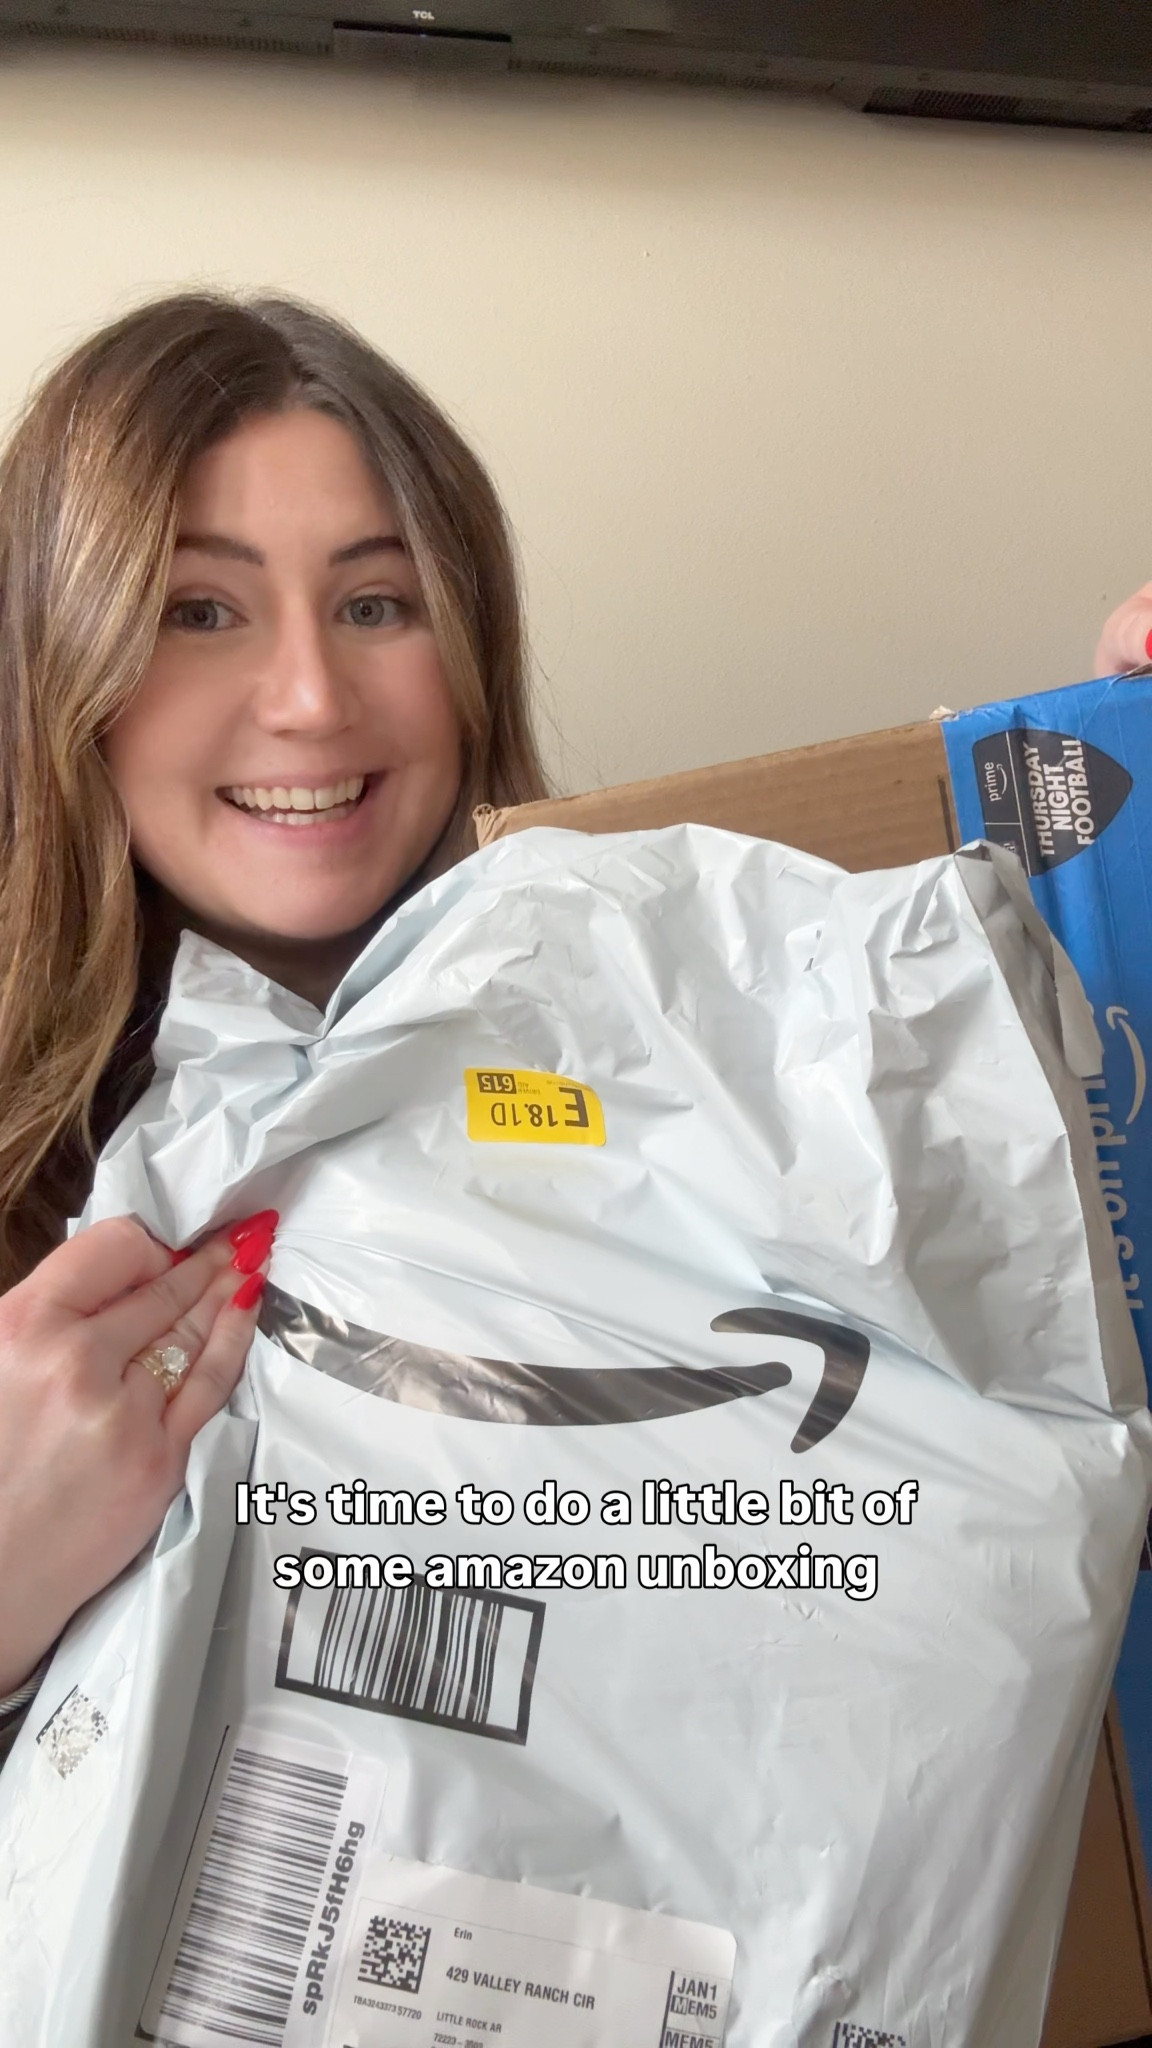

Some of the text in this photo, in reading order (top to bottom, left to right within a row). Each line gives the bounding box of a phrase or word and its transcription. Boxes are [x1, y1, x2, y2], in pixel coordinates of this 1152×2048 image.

[412, 10, 435, 20] TCL
[984, 762, 1002, 802] prime
[1023, 741, 1055, 856] THURSDAY
[1043, 764, 1073, 830] NIGHT
[481, 1074, 513, 1092] 615
[303, 1820, 365, 2016] spRkJ5fH6hg
[453, 1927, 473, 1941] Erin
[446, 1966, 595, 2010] 429 VALLEY RANCH CIR
[677, 1977, 717, 2001] JAN1
[670, 1995, 718, 2019] MEM5
[436, 2011, 502, 2033] LITTLE ROCK AR
